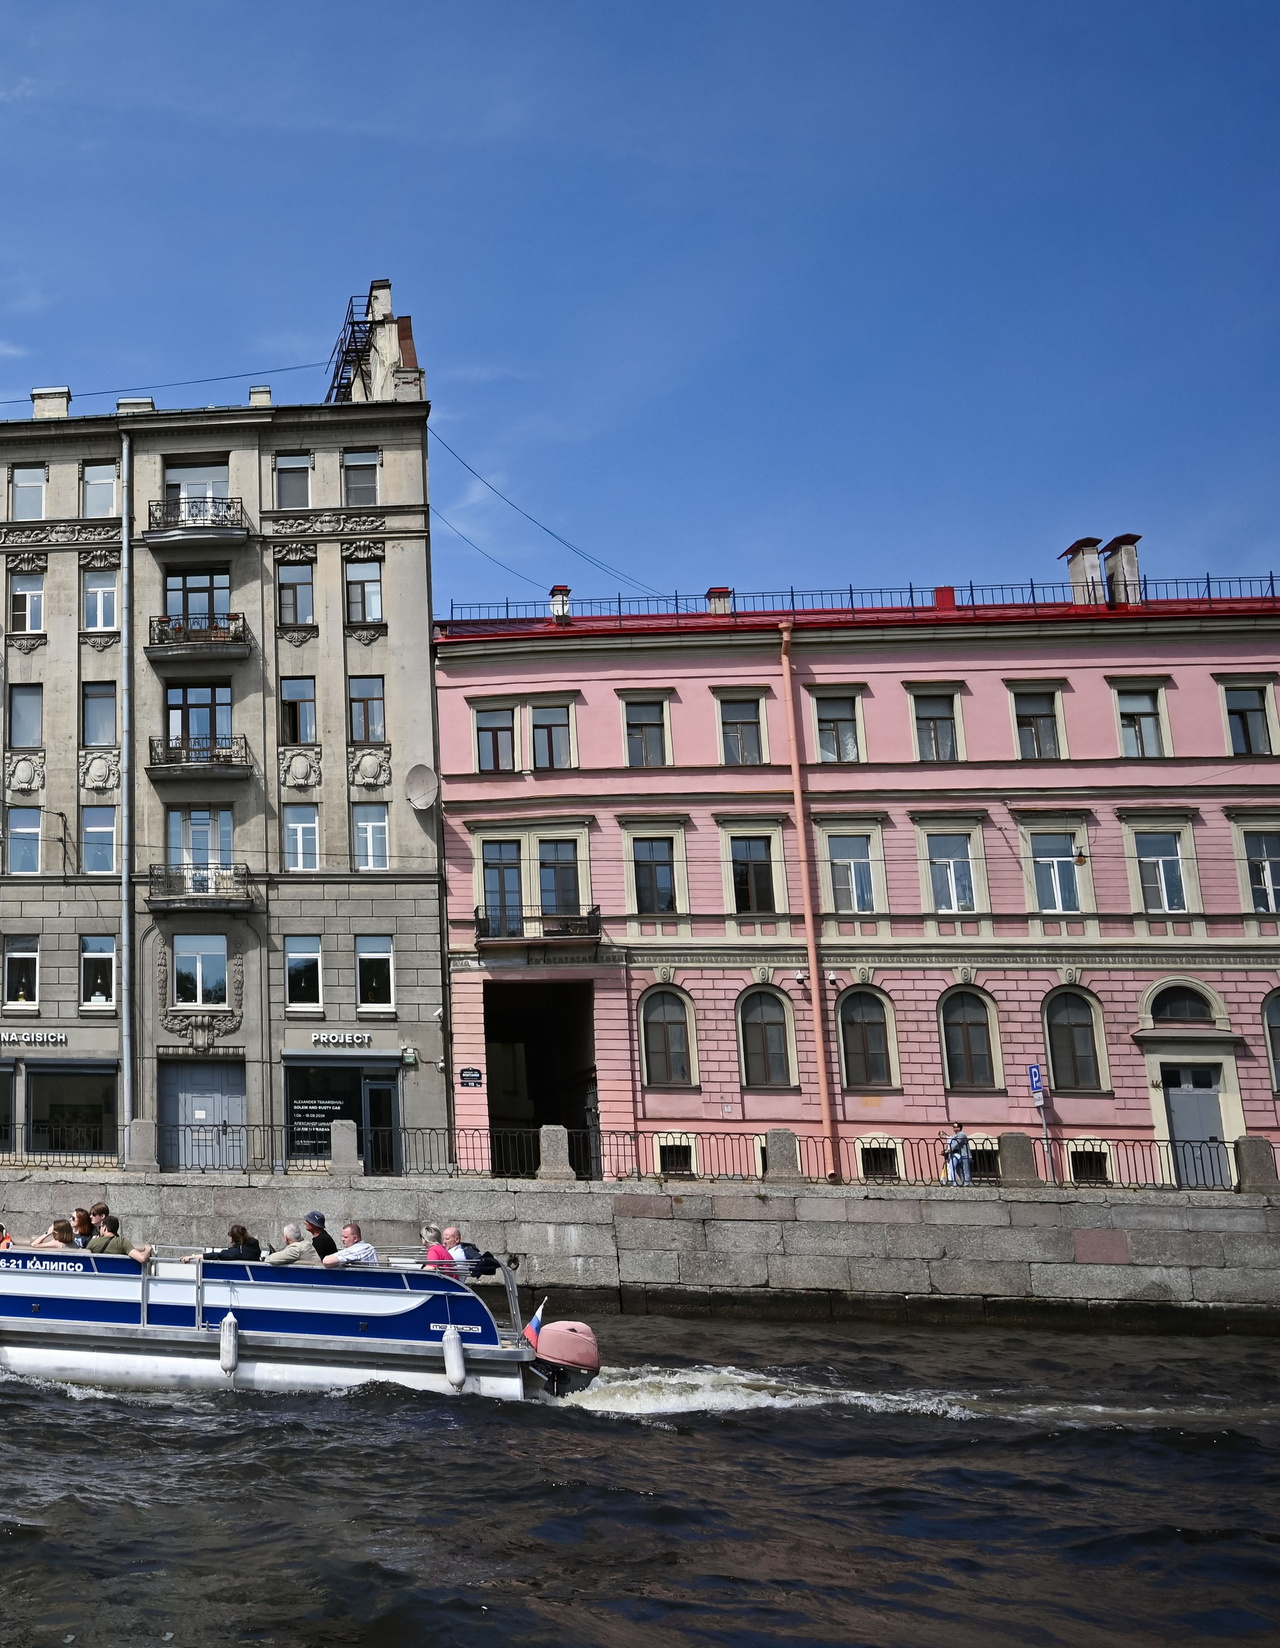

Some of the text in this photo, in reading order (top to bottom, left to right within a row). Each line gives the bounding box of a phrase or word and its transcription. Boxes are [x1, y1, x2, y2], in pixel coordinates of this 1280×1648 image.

[21, 1032, 66, 1043] GISICH
[311, 1032, 371, 1043] PROJECT
[26, 1260, 84, 1272] КАЛИПСО
